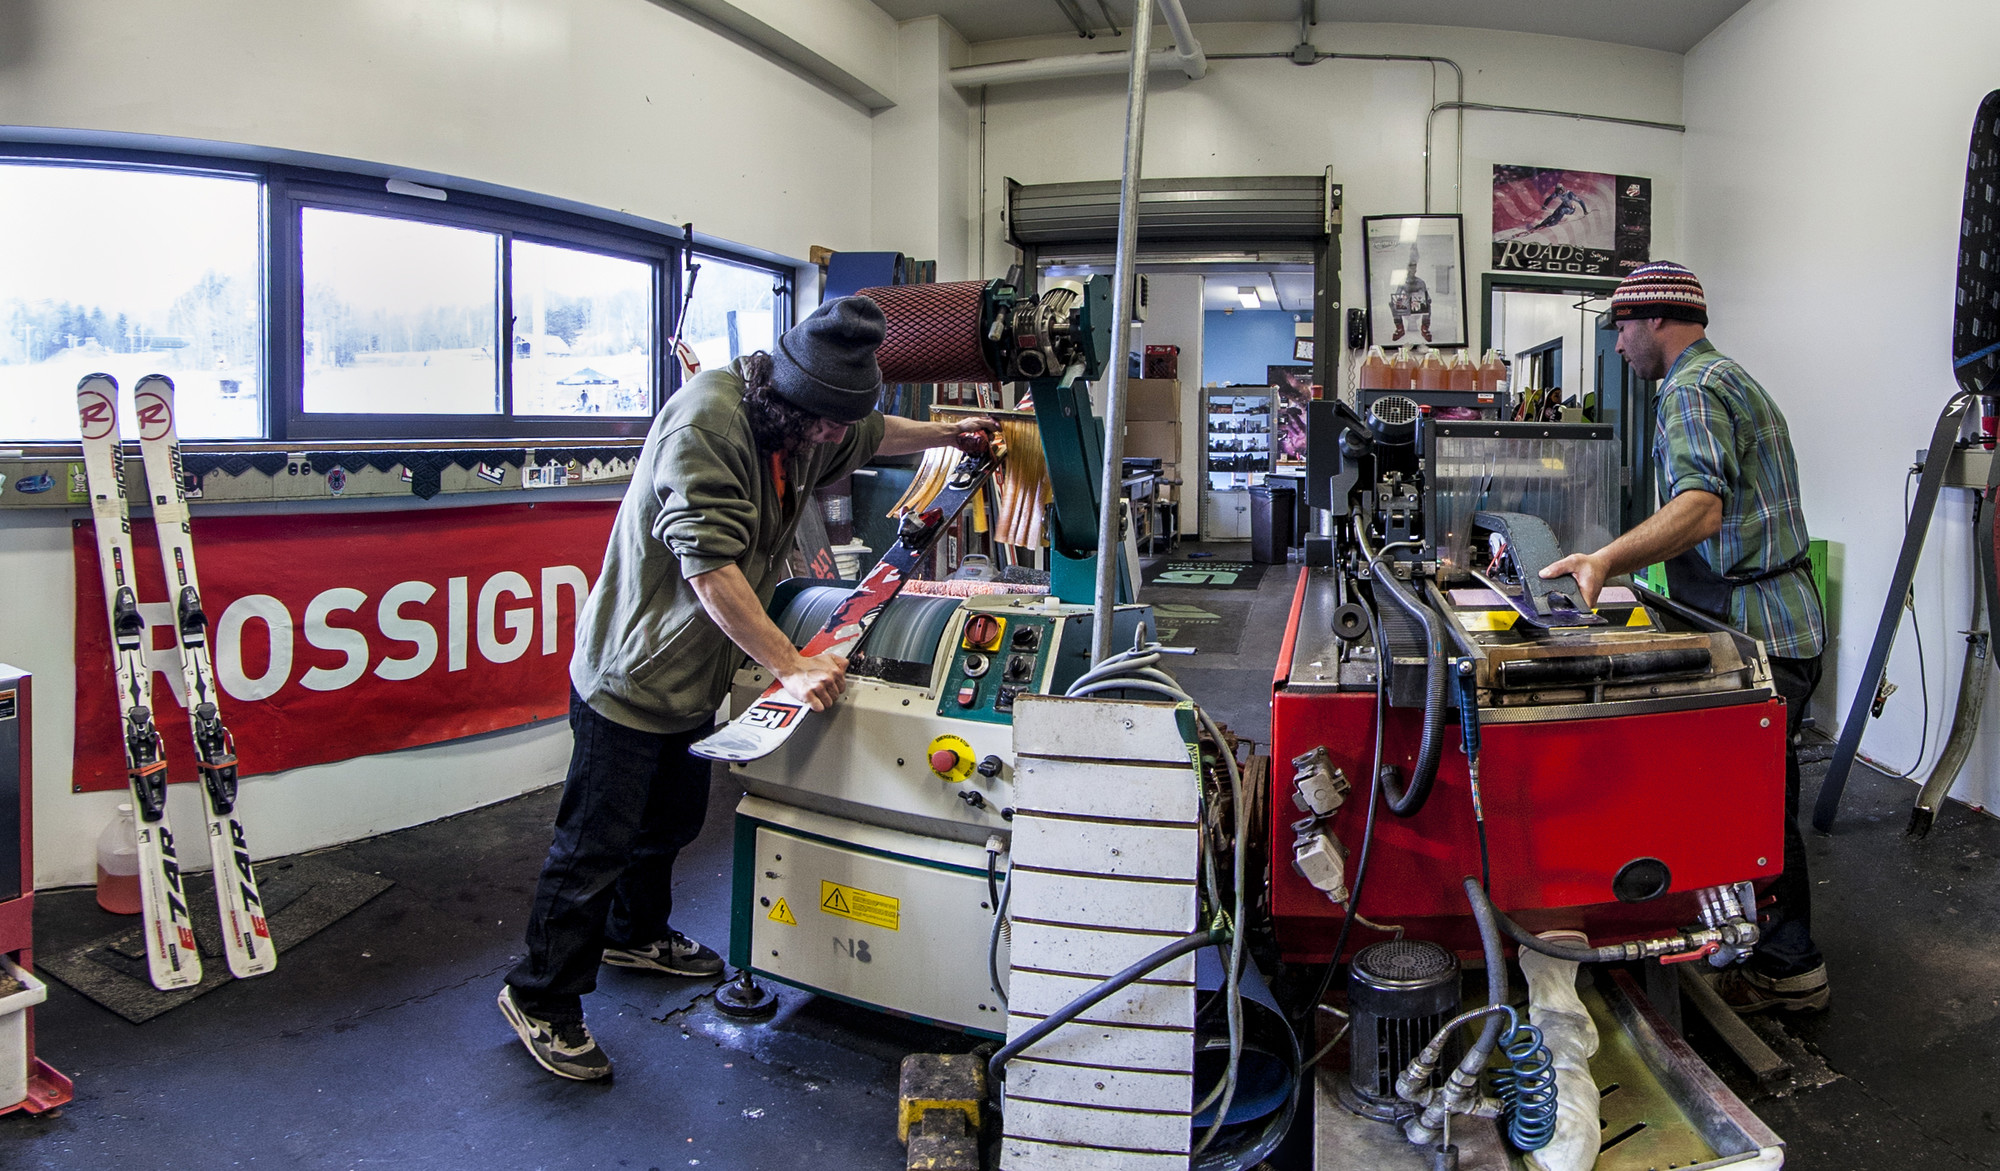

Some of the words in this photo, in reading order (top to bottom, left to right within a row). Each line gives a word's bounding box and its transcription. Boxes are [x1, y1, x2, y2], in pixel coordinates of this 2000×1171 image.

[1497, 241, 1574, 268] ROAD
[1527, 260, 1600, 273] 2002
[113, 441, 131, 534] ROSIGNOL
[171, 442, 191, 534] RSIGNOL
[935, 734, 960, 742] EMERGENCY
